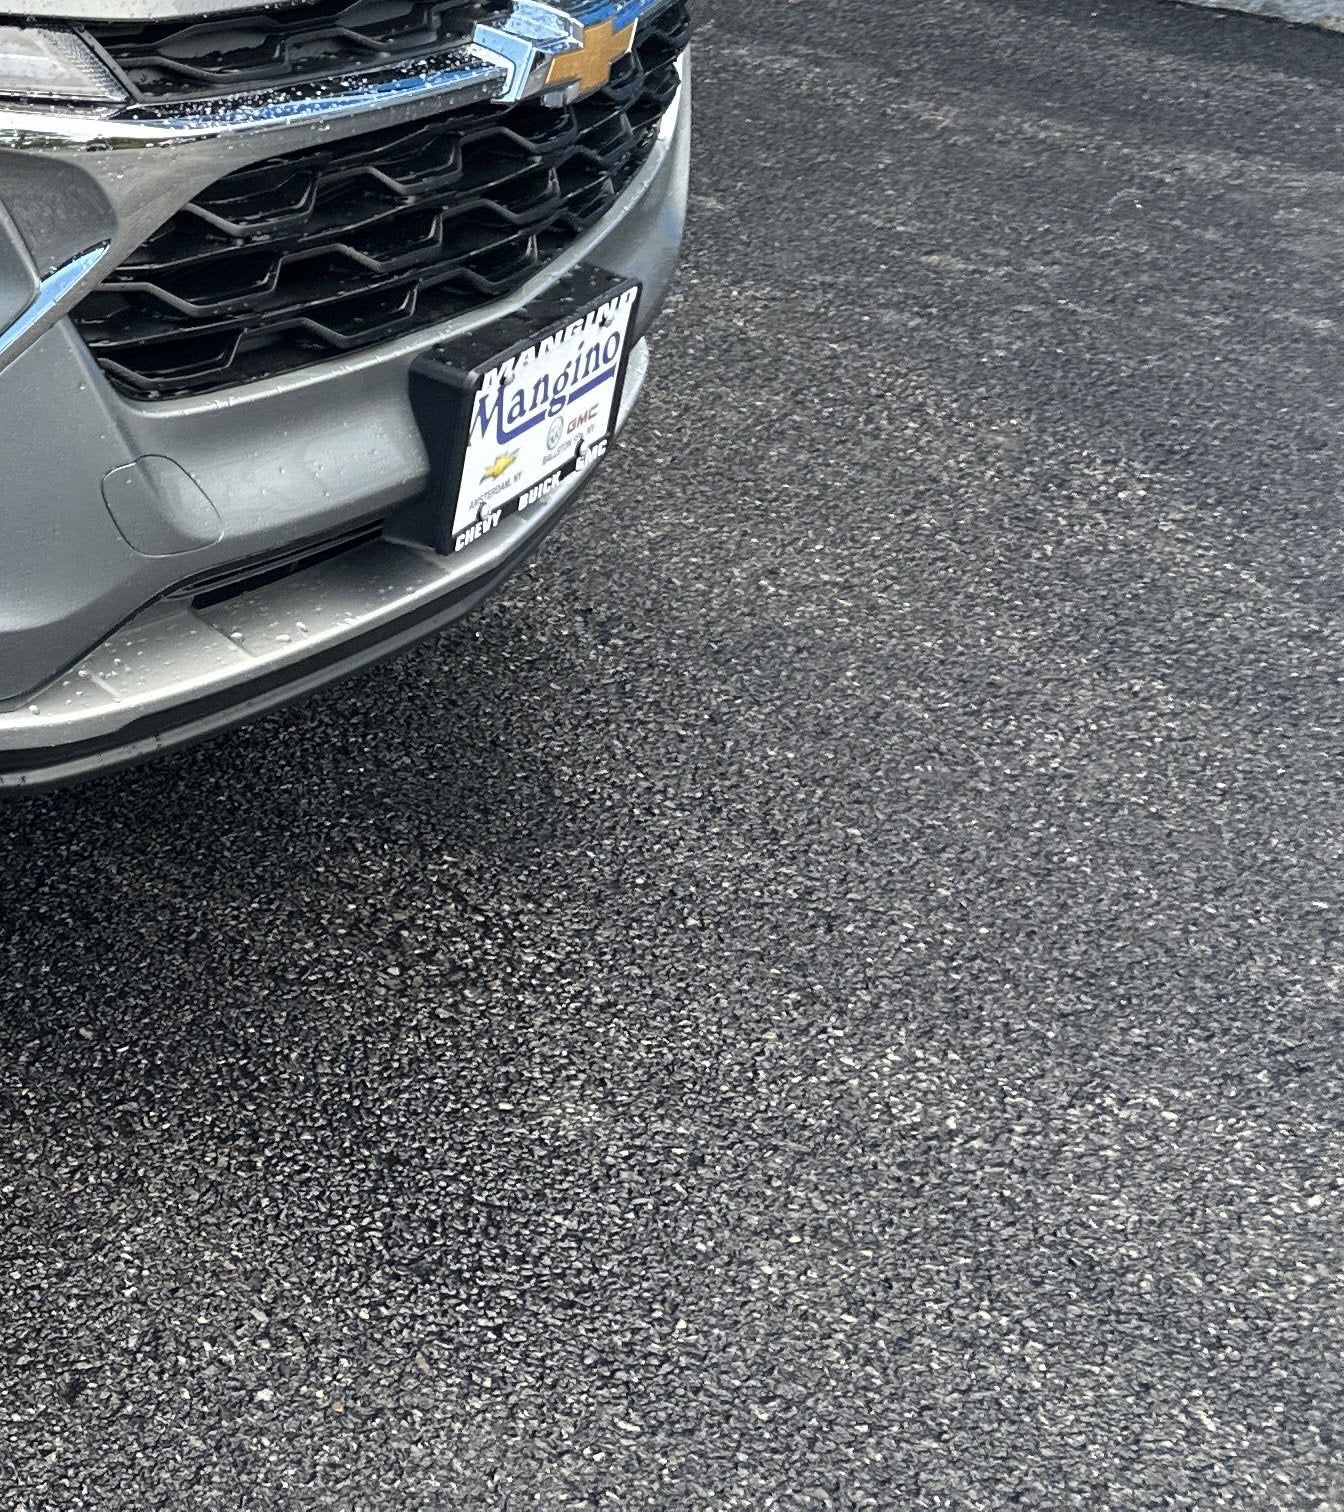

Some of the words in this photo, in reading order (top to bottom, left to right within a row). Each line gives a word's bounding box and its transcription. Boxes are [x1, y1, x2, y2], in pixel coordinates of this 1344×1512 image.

[468, 330, 620, 445] Mangino
[566, 403, 600, 434] GMC
[455, 508, 502, 551] CHEVY
[518, 470, 562, 511] BUICK
[575, 439, 608, 472] GMC
